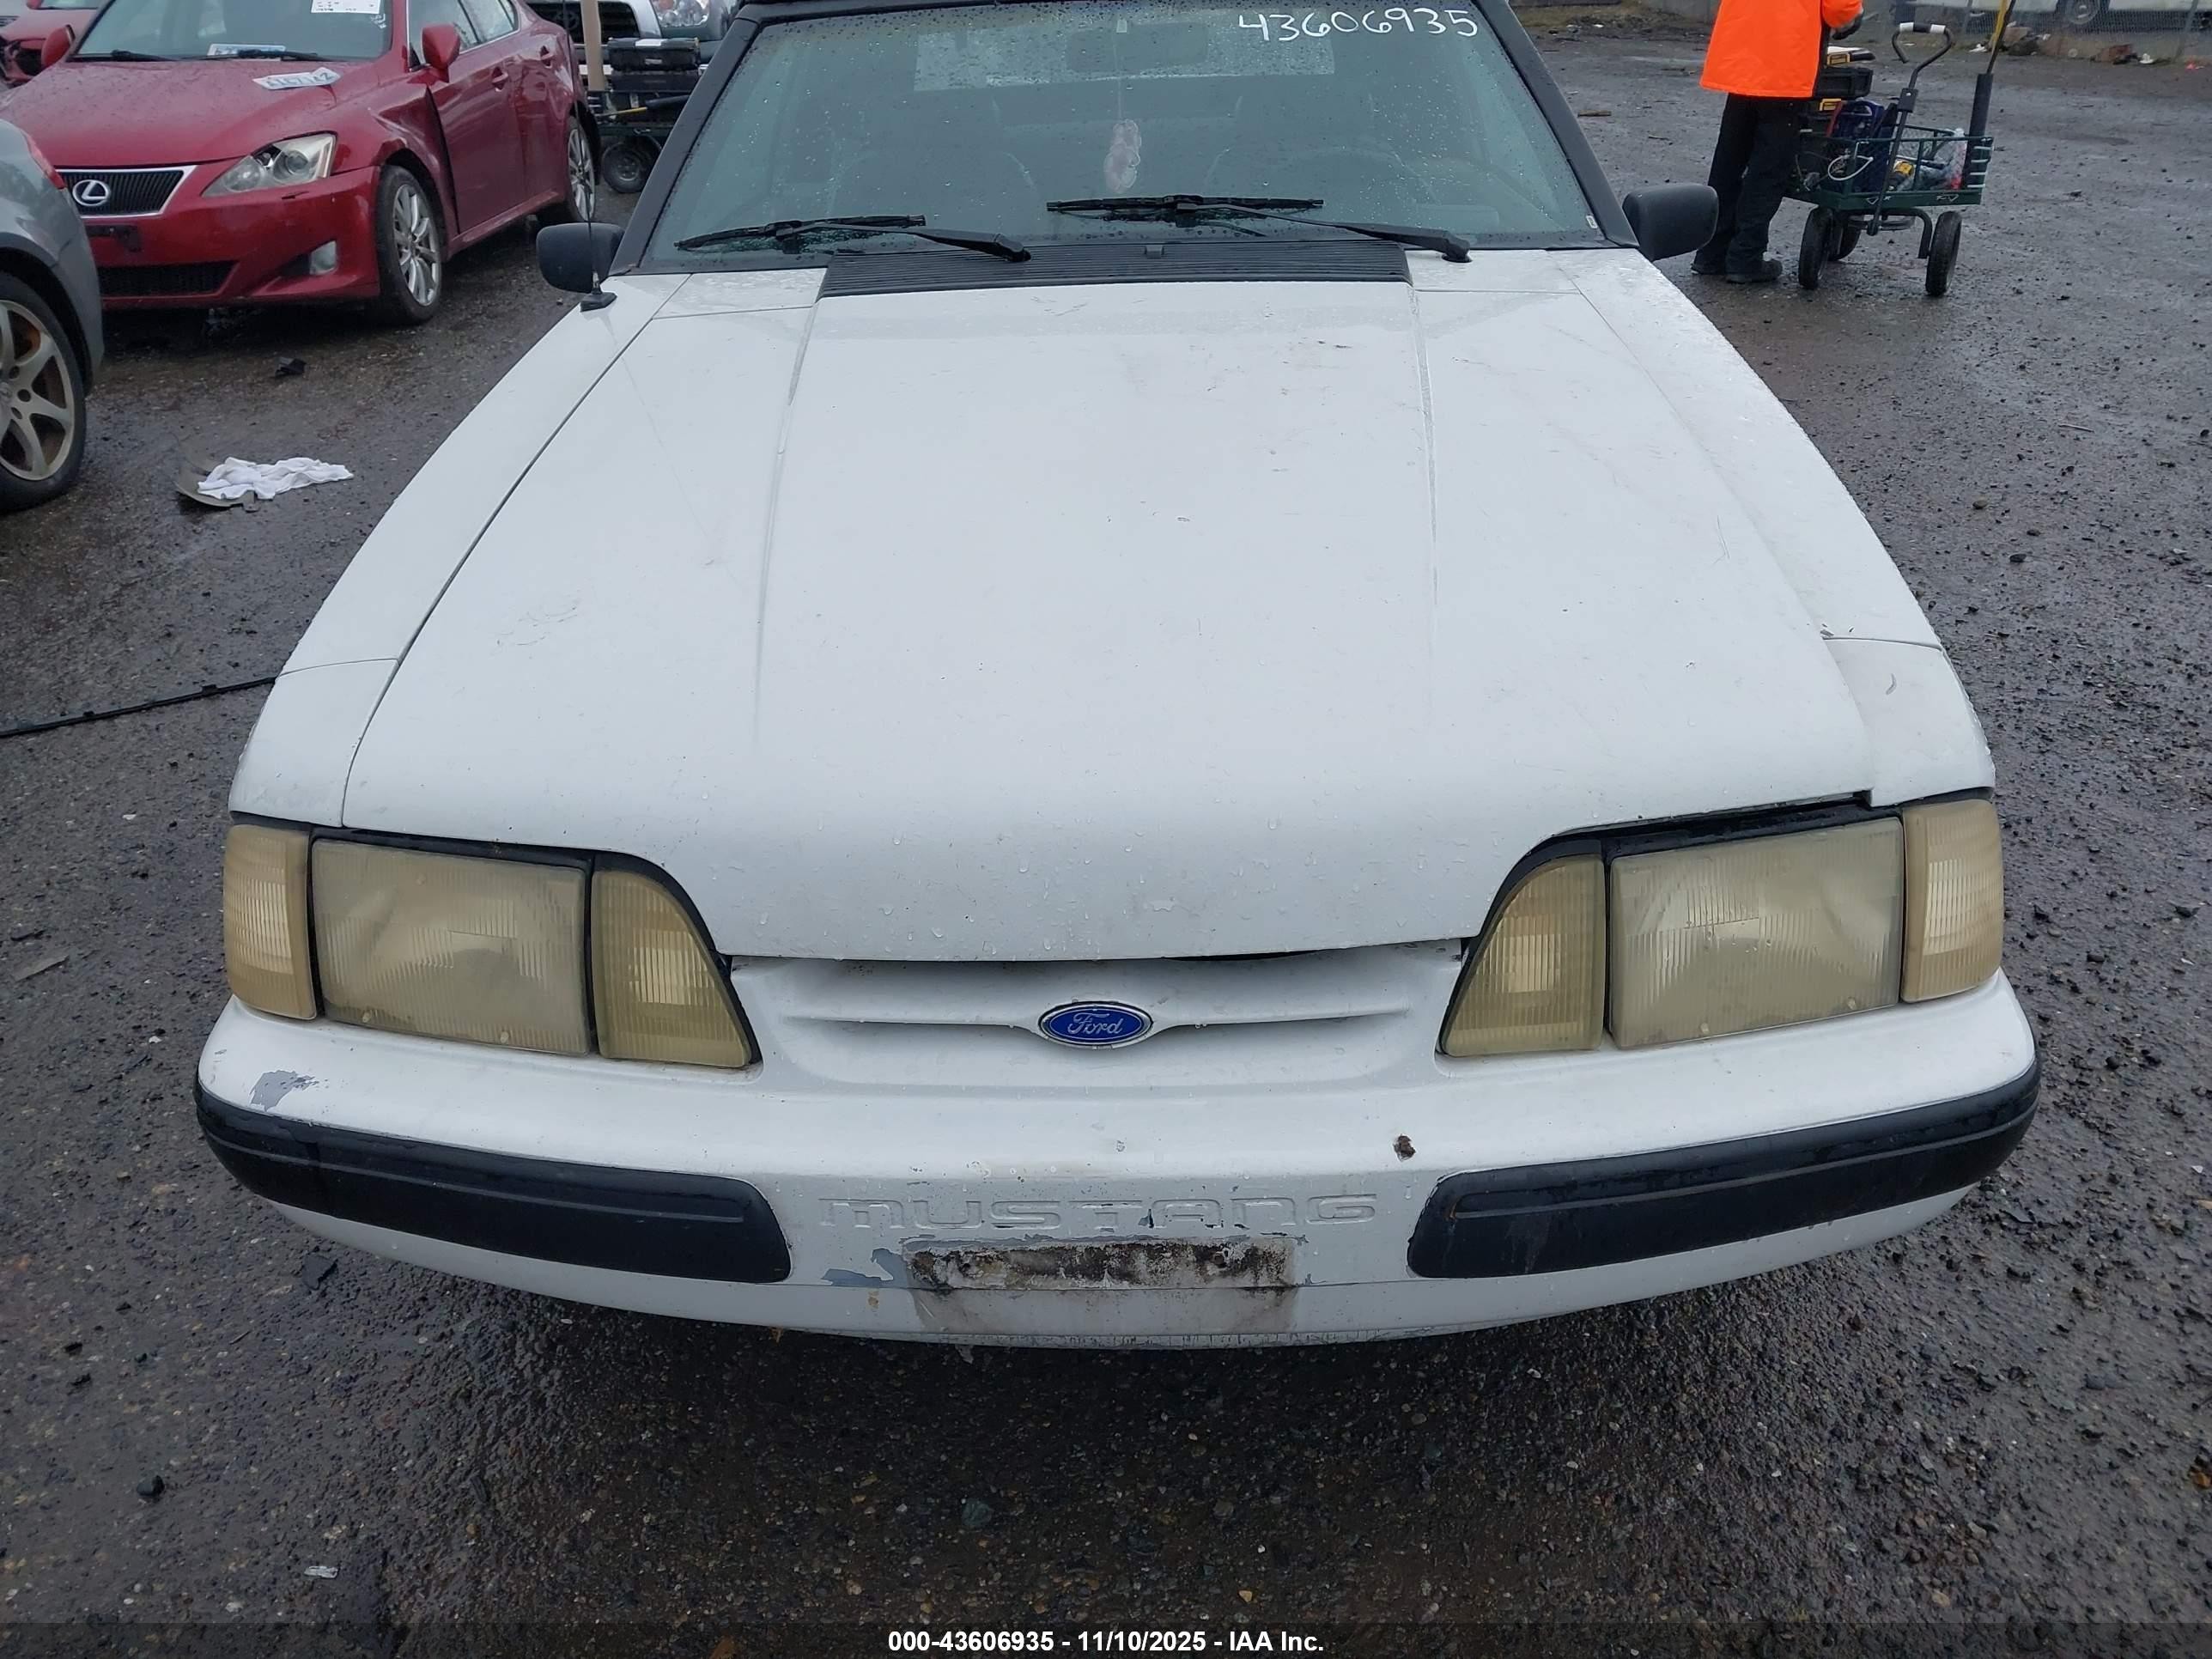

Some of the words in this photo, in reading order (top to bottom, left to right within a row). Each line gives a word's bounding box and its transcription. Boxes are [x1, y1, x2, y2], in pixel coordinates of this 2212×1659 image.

[1238, 7, 1478, 41] 43606935
[1067, 1012, 1124, 1035] Ford
[818, 1194, 1376, 1230] MUSTANG
